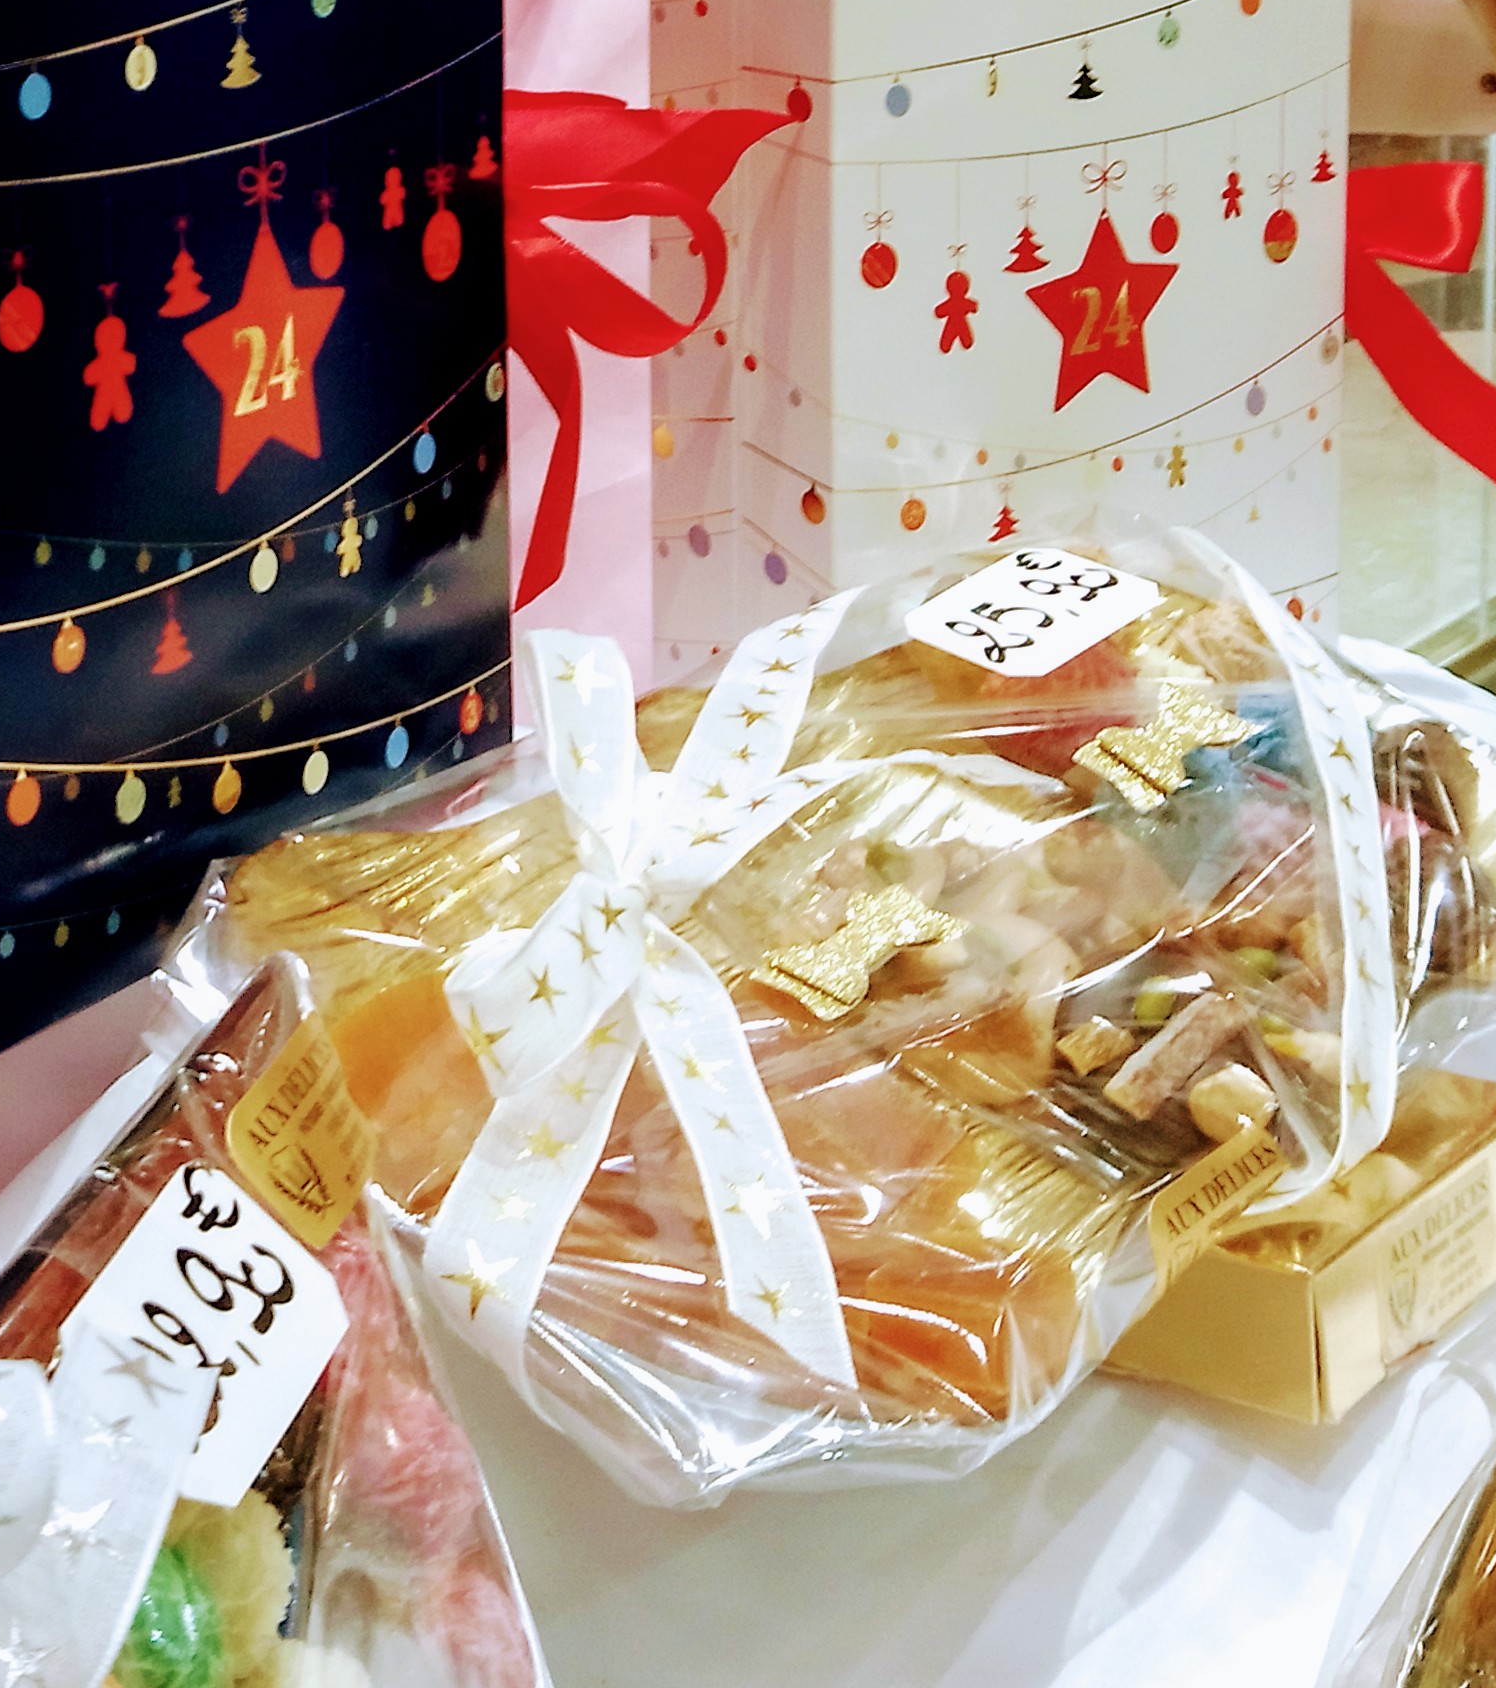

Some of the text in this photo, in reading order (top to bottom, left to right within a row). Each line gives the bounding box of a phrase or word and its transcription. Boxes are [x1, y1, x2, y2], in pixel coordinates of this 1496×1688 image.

[1070, 279, 1140, 356] 24
[233, 315, 305, 417] 24
[248, 1096, 291, 1150] AUX
[1165, 1140, 1279, 1238] AUX DÉLICES
